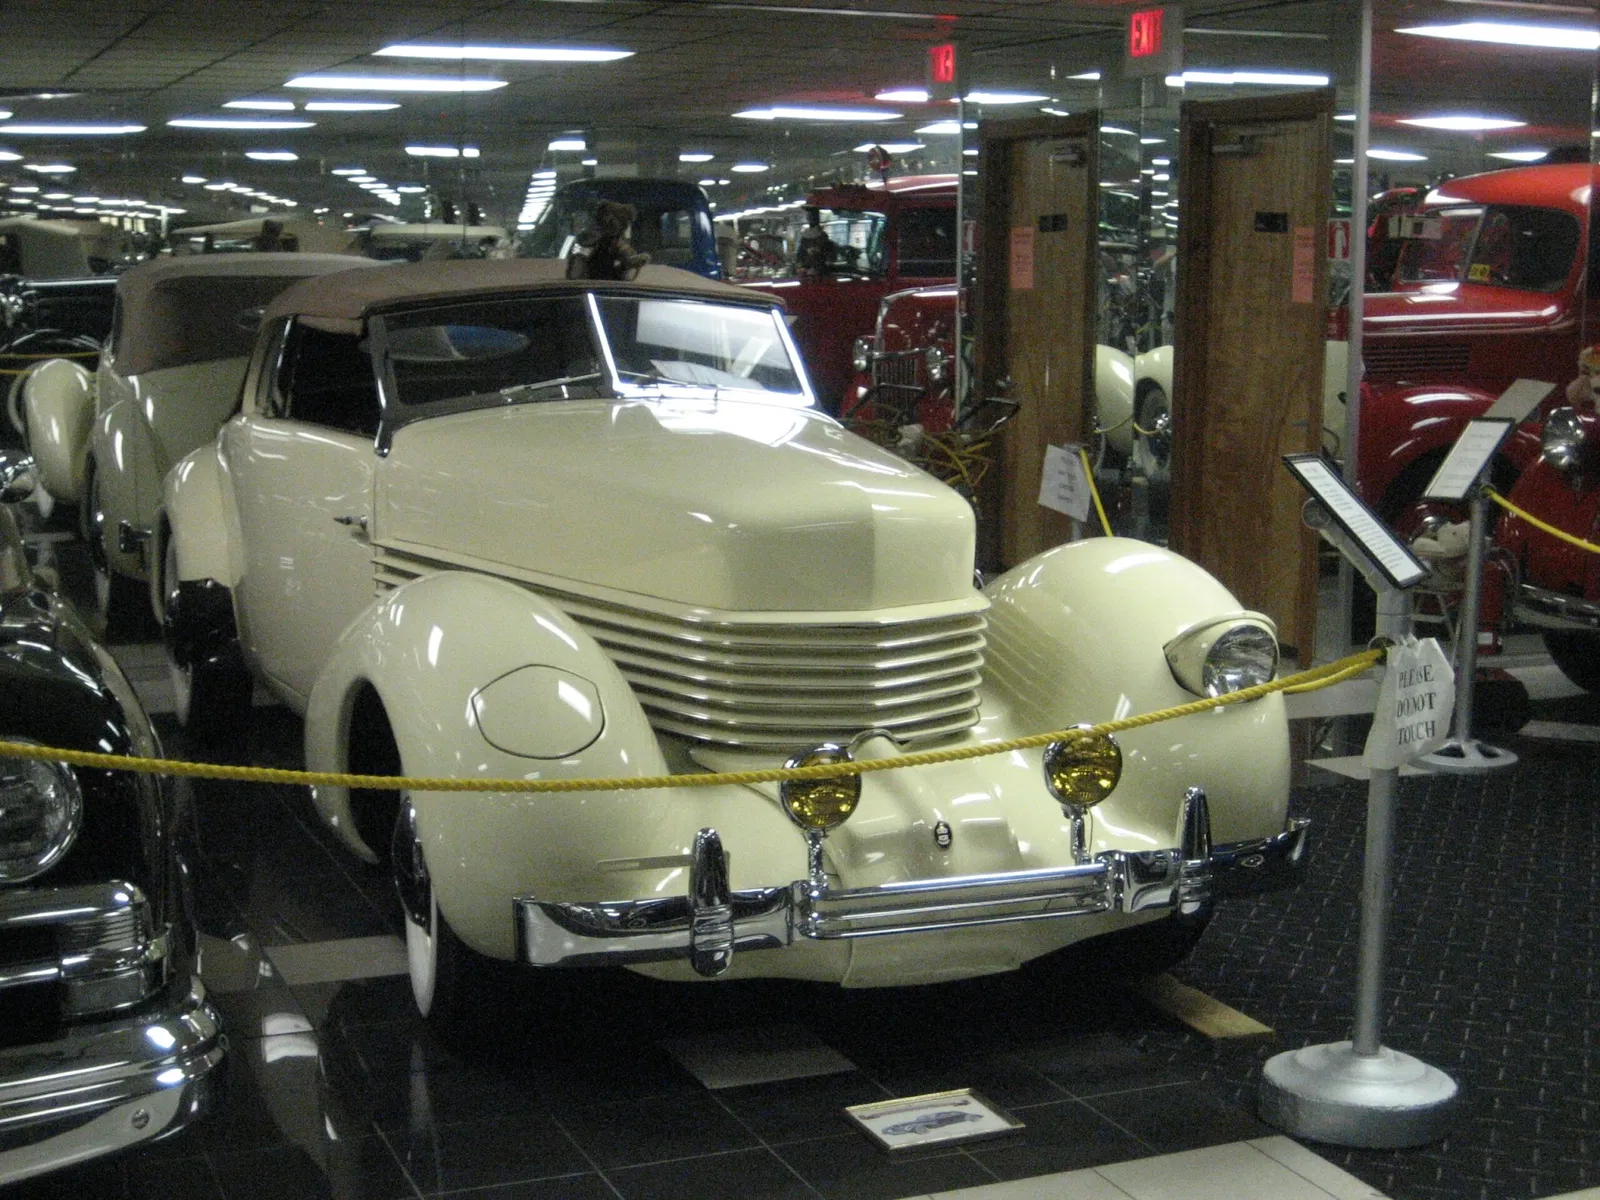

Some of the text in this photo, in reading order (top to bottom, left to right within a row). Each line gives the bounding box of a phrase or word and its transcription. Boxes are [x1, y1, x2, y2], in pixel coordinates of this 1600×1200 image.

[1131, 9, 1163, 57] EXIT
[1398, 664, 1435, 689] PLEASE
[1396, 692, 1437, 718] DO NOT
[1397, 720, 1436, 745] TOUCH
